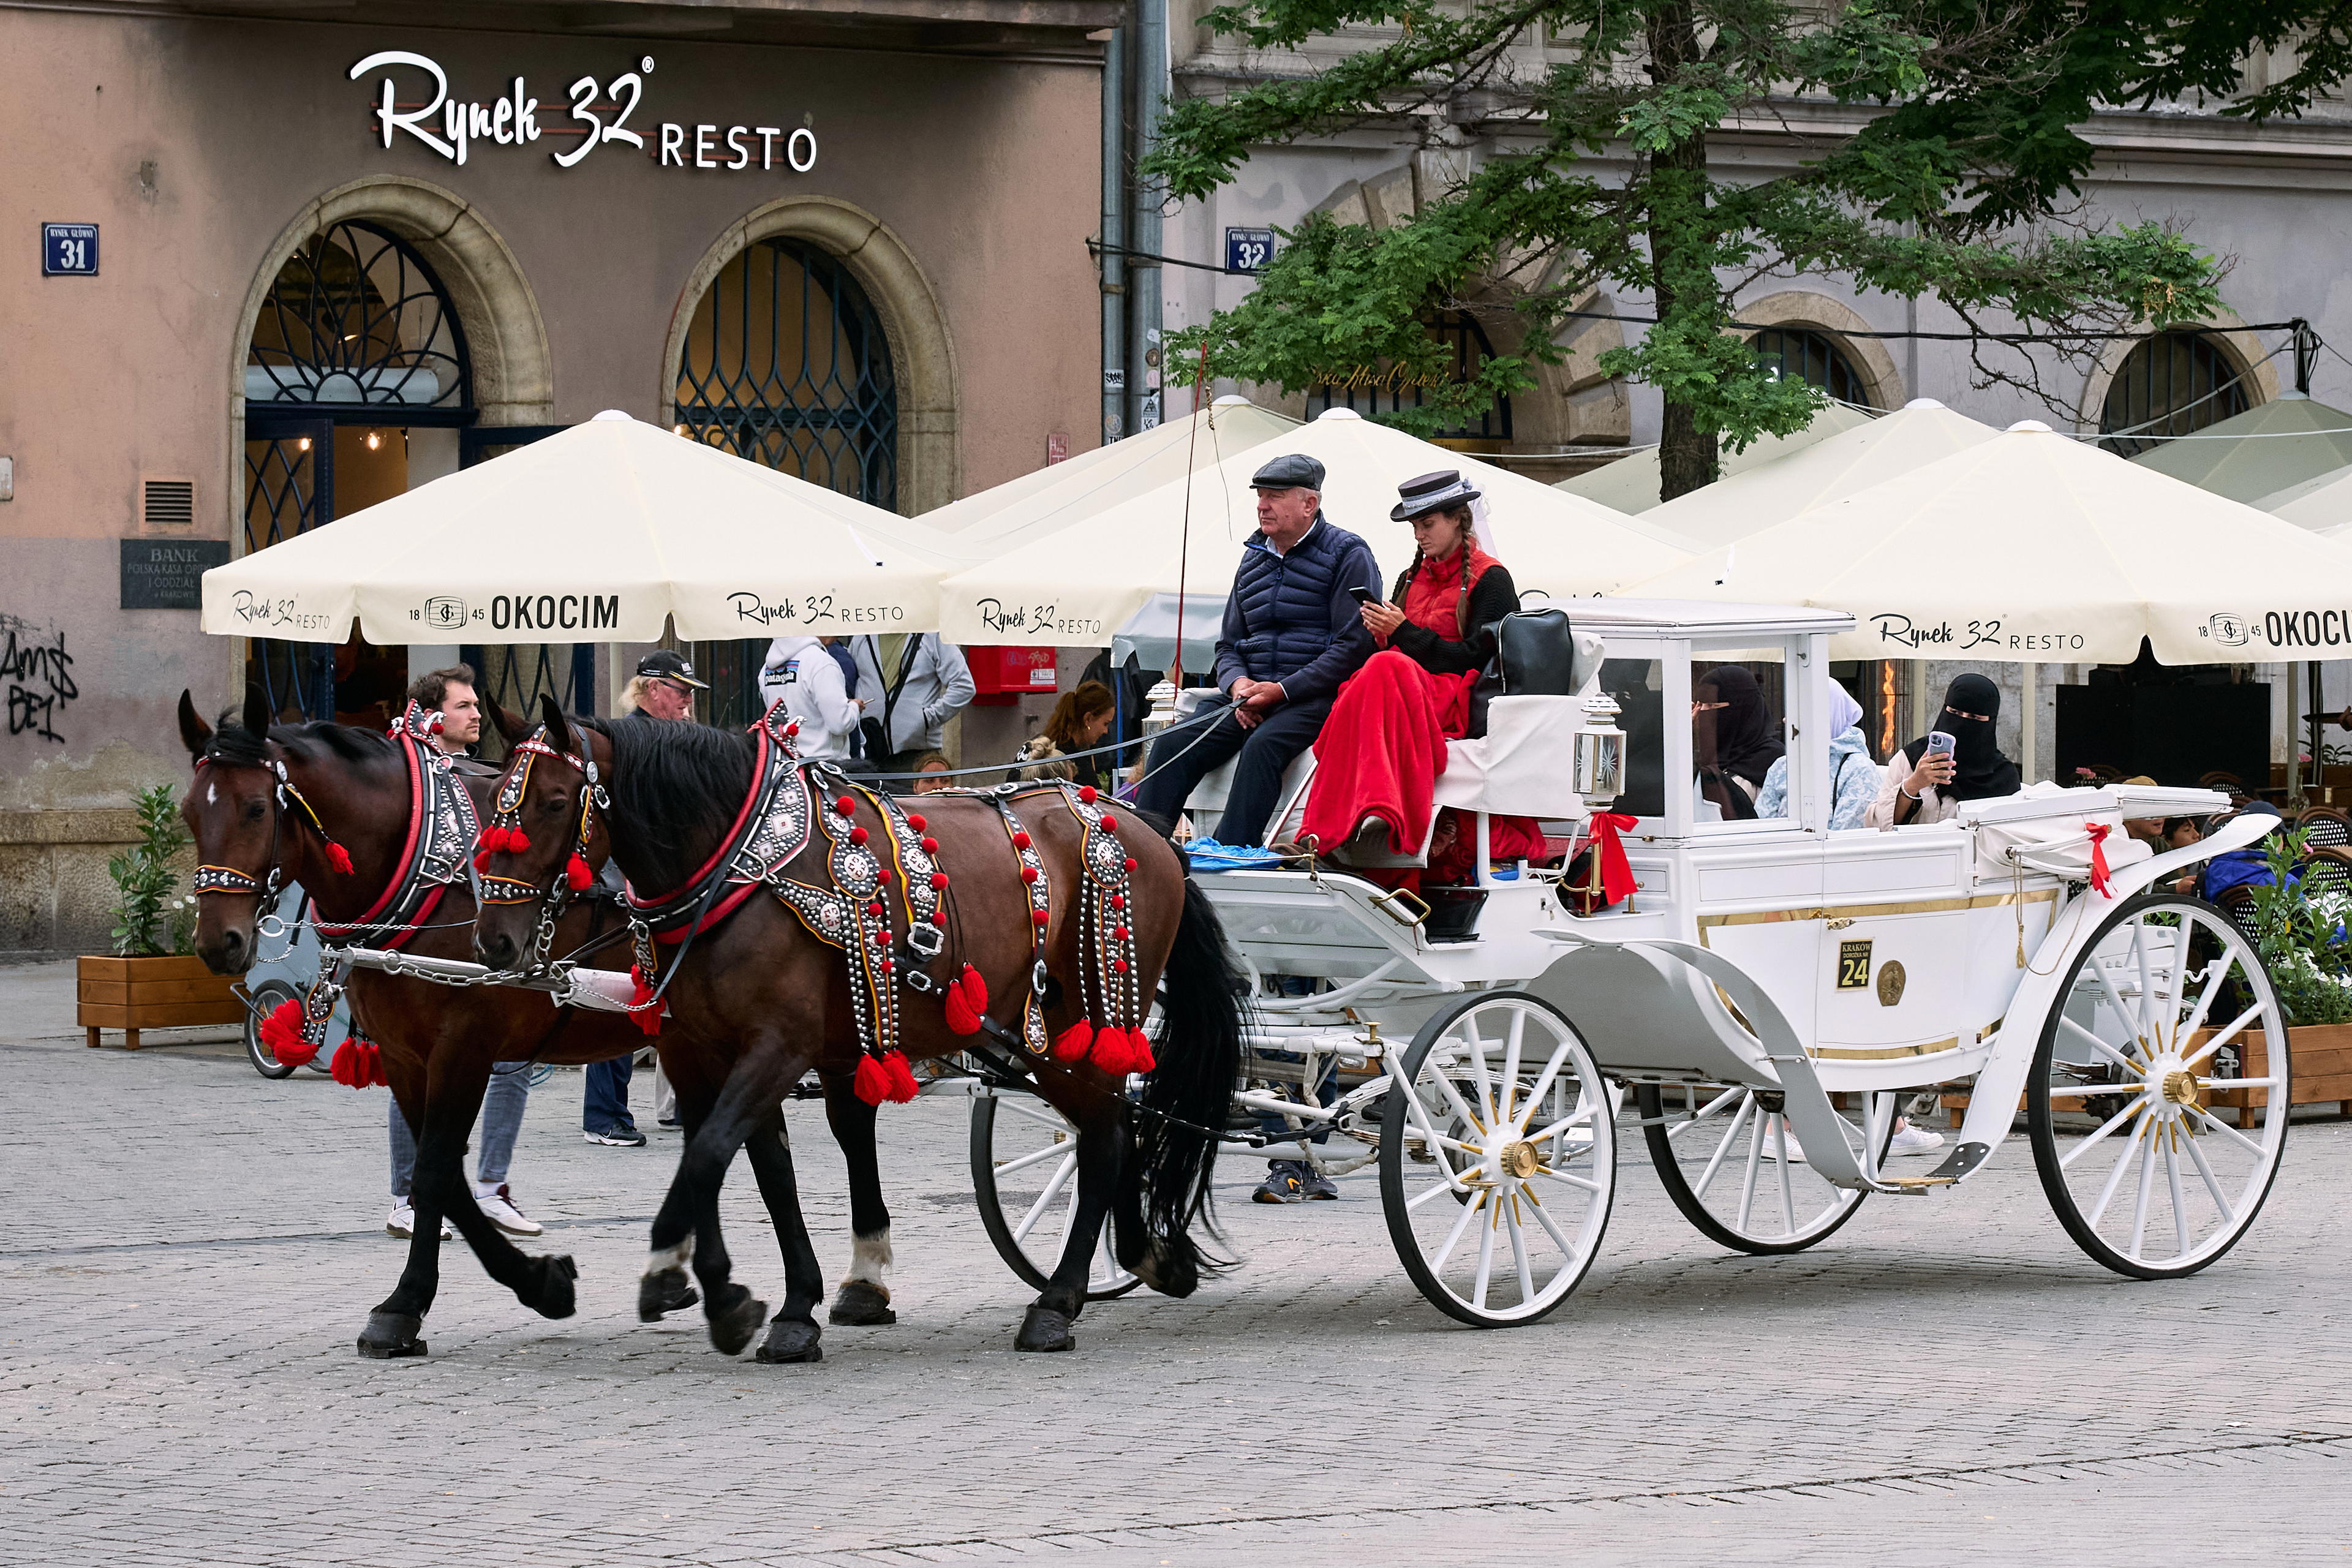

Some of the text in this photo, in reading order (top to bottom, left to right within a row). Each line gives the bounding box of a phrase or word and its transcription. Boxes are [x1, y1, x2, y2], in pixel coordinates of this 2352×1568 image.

[350, 50, 541, 166] Rynek
[554, 72, 644, 168] 32
[662, 123, 817, 172] RESTO
[50, 228, 69, 237] RYNEK
[60, 239, 86, 269] 31
[1238, 243, 1265, 269] 32
[127, 563, 160, 575] POLSKA
[162, 564, 183, 575] KASA
[150, 548, 198, 562] BANK
[232, 590, 330, 630] Rynek 32 RESTO
[409, 609, 420, 620] 18
[472, 609, 484, 620] 45
[492, 595, 619, 630] OKOCIM
[726, 592, 903, 625] Rynek 32 RESTO
[977, 598, 1101, 634] Rynek 32 RESTO
[1869, 613, 2084, 649] Rynek 32 RESTO
[2198, 626, 2208, 637] 18
[2251, 625, 2261, 636] 45
[2265, 610, 2352, 647] OKOCI
[1842, 959, 1868, 986] 24
